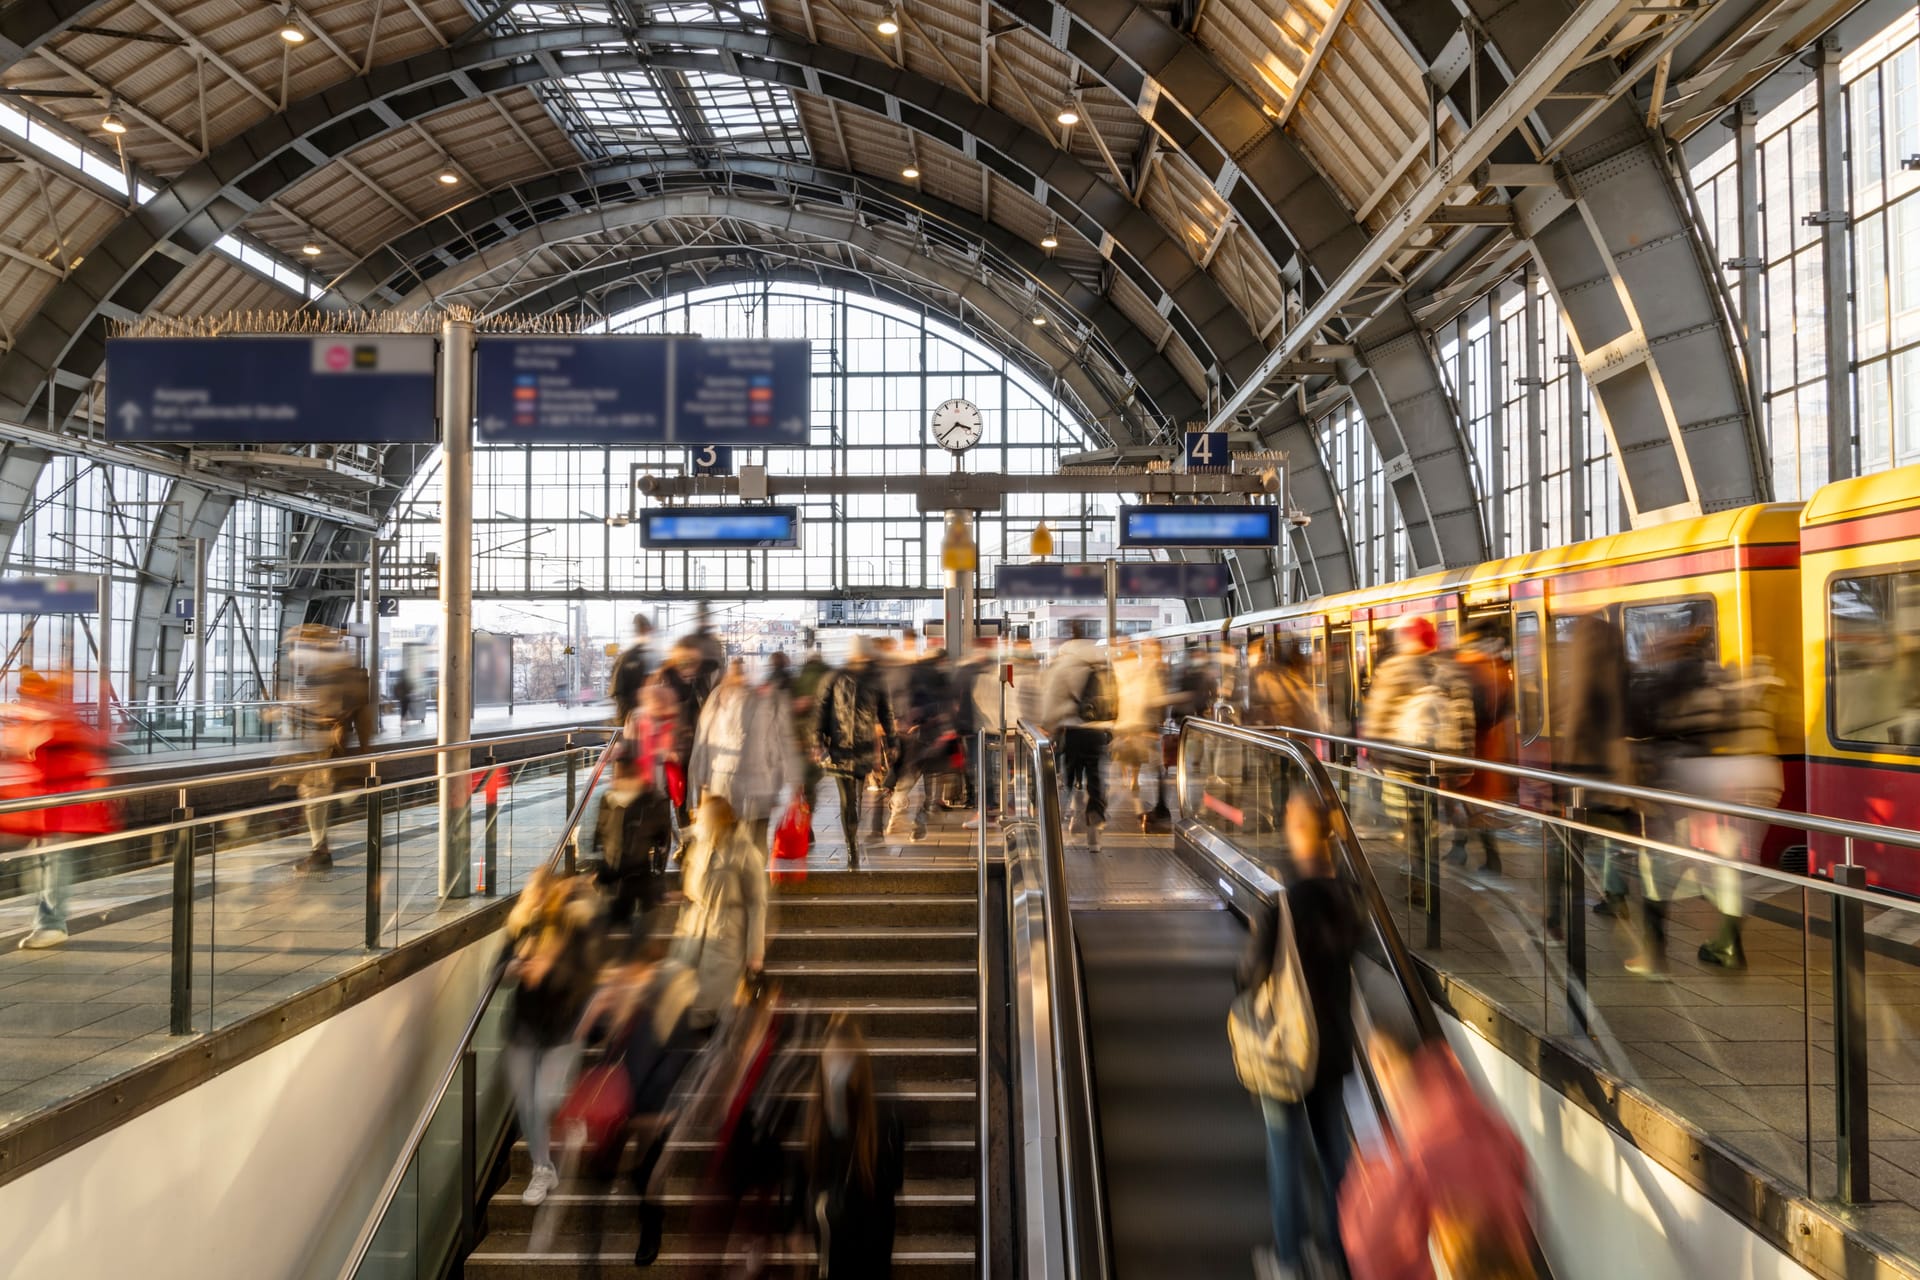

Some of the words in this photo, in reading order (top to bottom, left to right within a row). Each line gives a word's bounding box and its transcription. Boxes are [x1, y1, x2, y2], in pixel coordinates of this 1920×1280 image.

[696, 445, 717, 467] 3
[1191, 433, 1213, 465] 4
[178, 599, 185, 614] 1
[387, 598, 397, 613] 2
[185, 620, 194, 633] H
